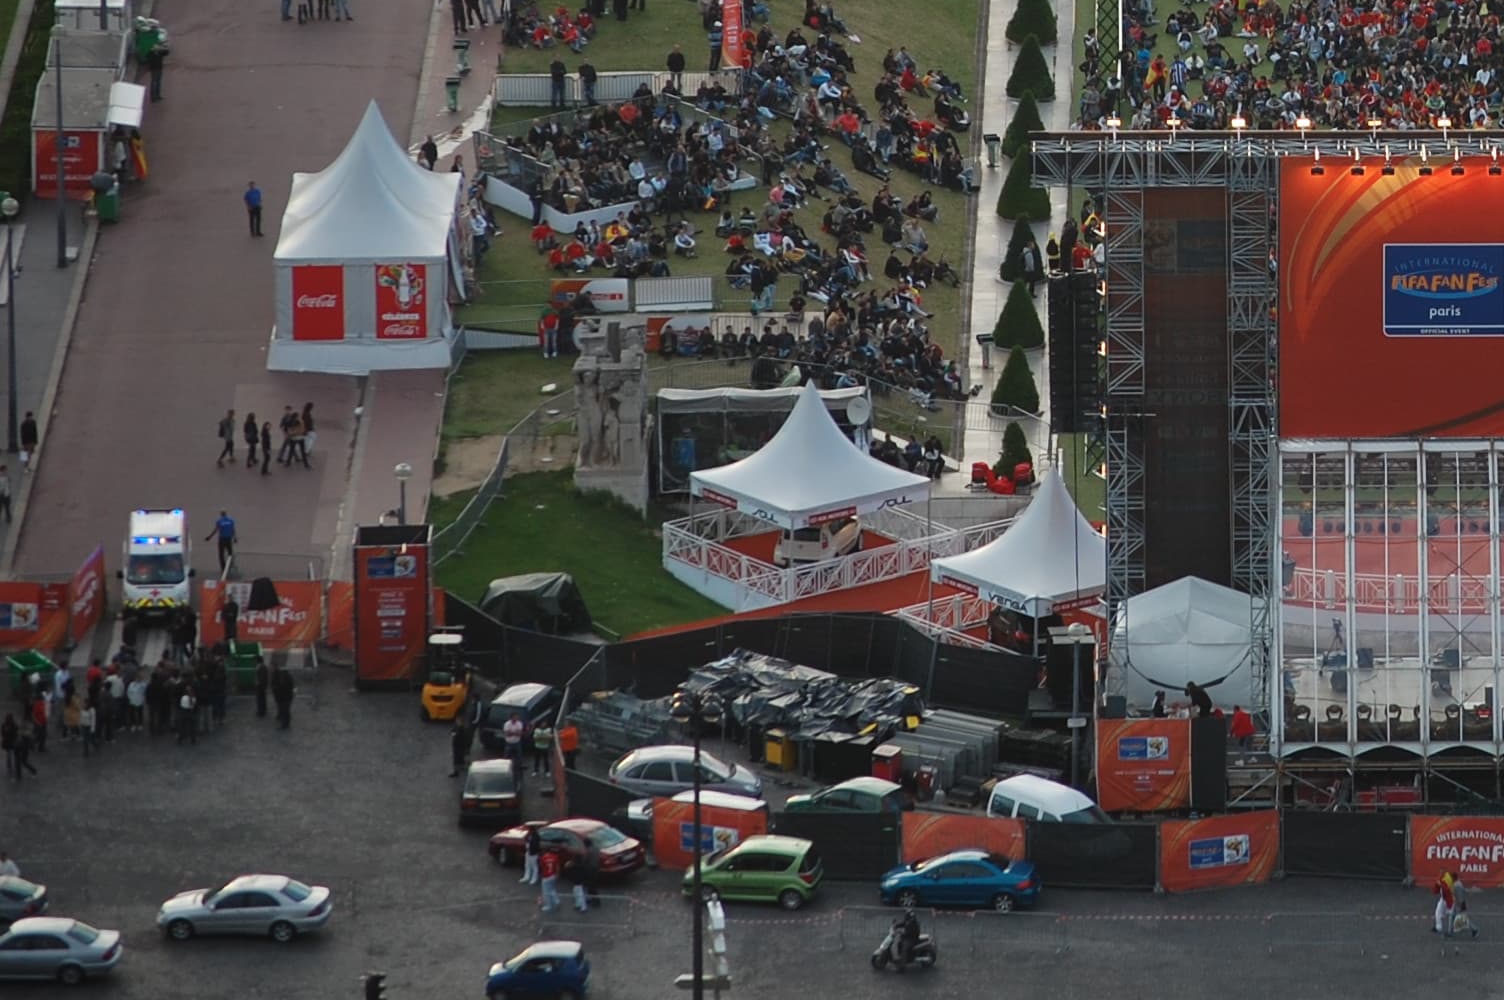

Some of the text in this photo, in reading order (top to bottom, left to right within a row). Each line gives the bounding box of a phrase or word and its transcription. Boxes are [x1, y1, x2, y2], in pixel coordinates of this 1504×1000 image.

[1393, 257, 1495, 273] INTERNATIONAL
[1391, 273, 1499, 293] FIFA FAN FEST
[1429, 304, 1461, 319] paris
[1427, 845, 1460, 860] FIFA
[1461, 846, 1490, 861] FAN
[1460, 864, 1488, 872] PARIS
